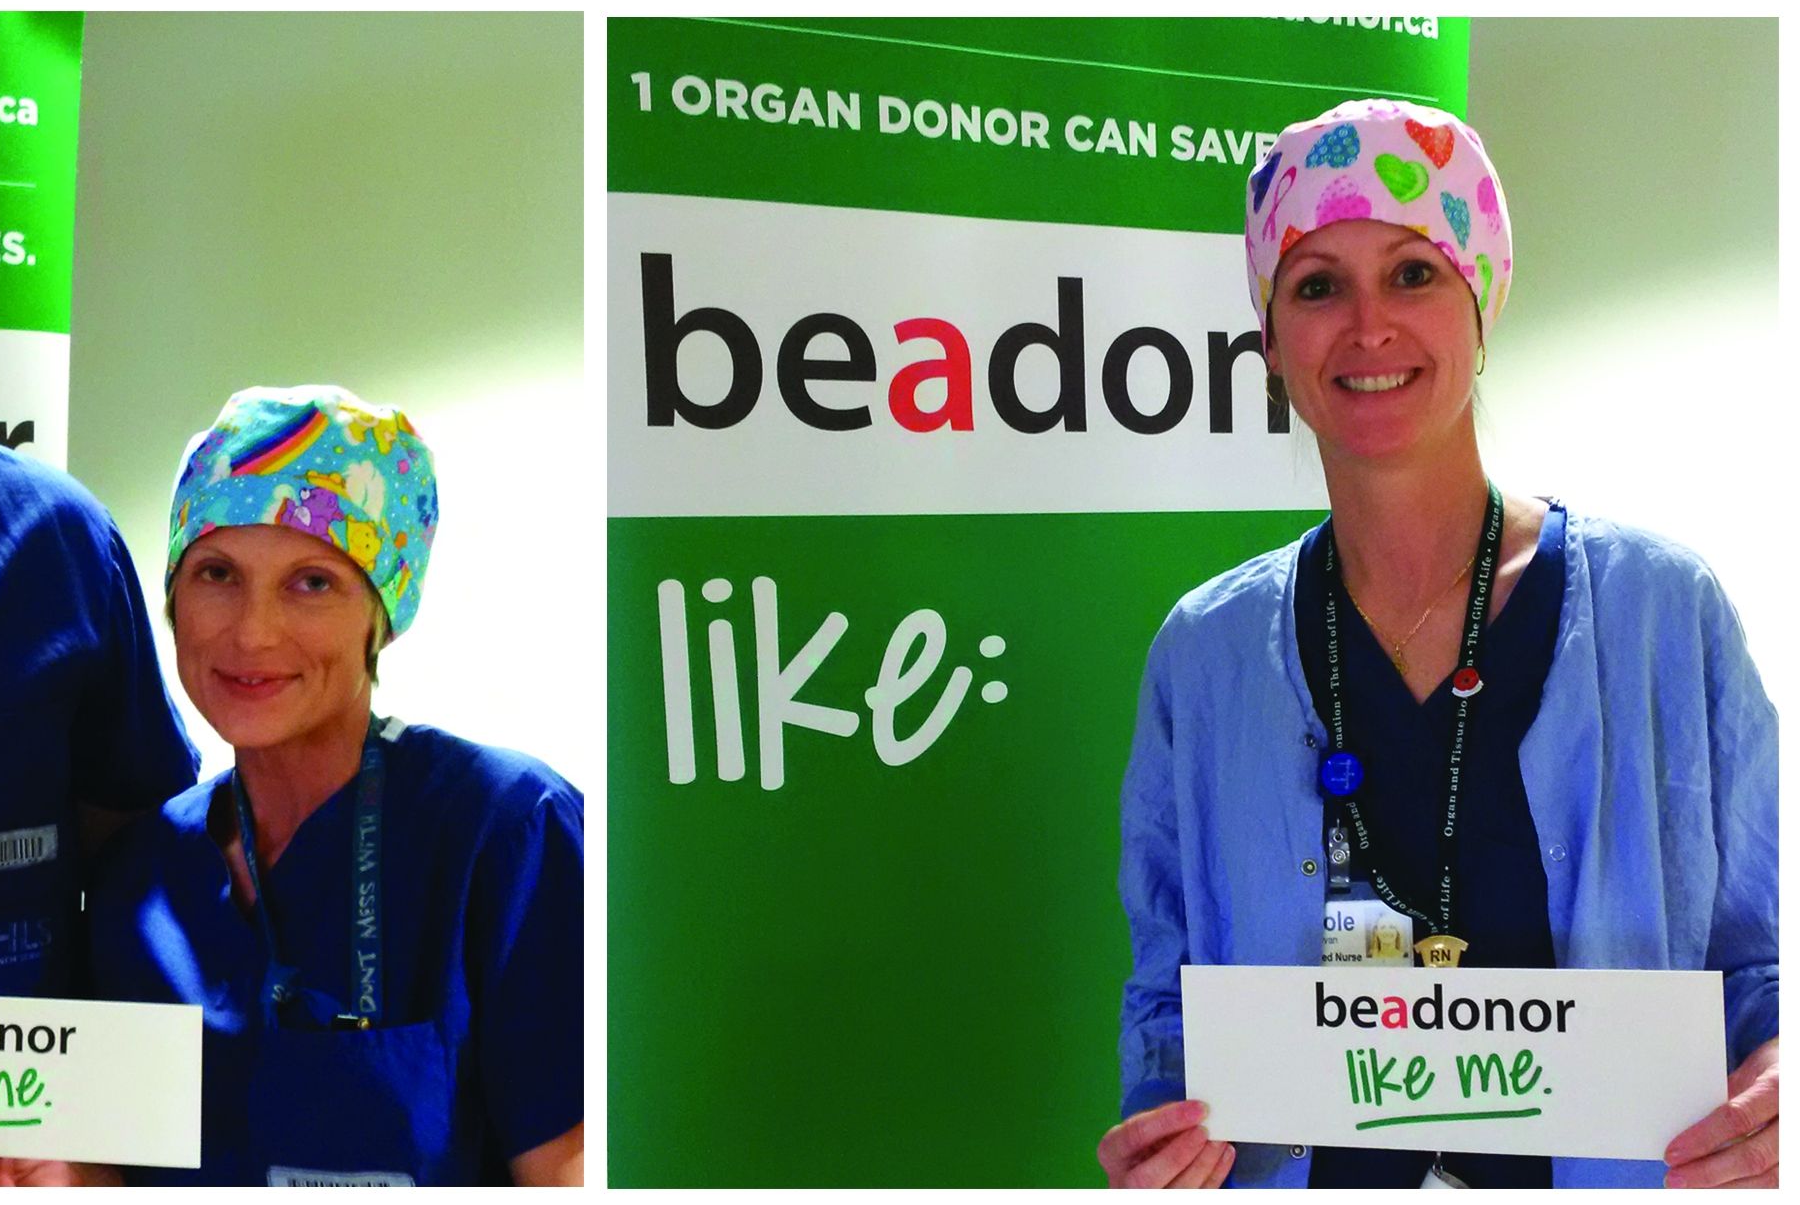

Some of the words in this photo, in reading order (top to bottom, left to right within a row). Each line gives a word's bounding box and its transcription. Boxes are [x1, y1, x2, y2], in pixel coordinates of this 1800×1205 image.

[630, 71, 653, 112] 1
[670, 74, 861, 131] ORGAN
[879, 96, 1051, 150] DONOR
[1065, 116, 1157, 159] CAN
[1479, 556, 1492, 579] Life
[1478, 581, 1488, 594] of
[1326, 600, 1336, 623] Life
[1471, 596, 1485, 620] Gift
[1327, 626, 1337, 637] of
[1467, 623, 1479, 646] The
[1328, 639, 1338, 663] Gift
[657, 576, 1008, 790] like:
[1330, 665, 1340, 689] The
[1450, 721, 1465, 764] Tissue
[1449, 767, 1460, 791] and
[1443, 795, 1457, 837] Organ
[1376, 875, 1396, 902] Life
[1440, 875, 1451, 902] Life
[1440, 906, 1450, 920] of
[1335, 952, 1363, 962] Nurse
[1430, 950, 1452, 963] RN
[1315, 981, 1576, 1033] beadonor
[1346, 1048, 1435, 1106] like
[1456, 1049, 1552, 1098] me.
